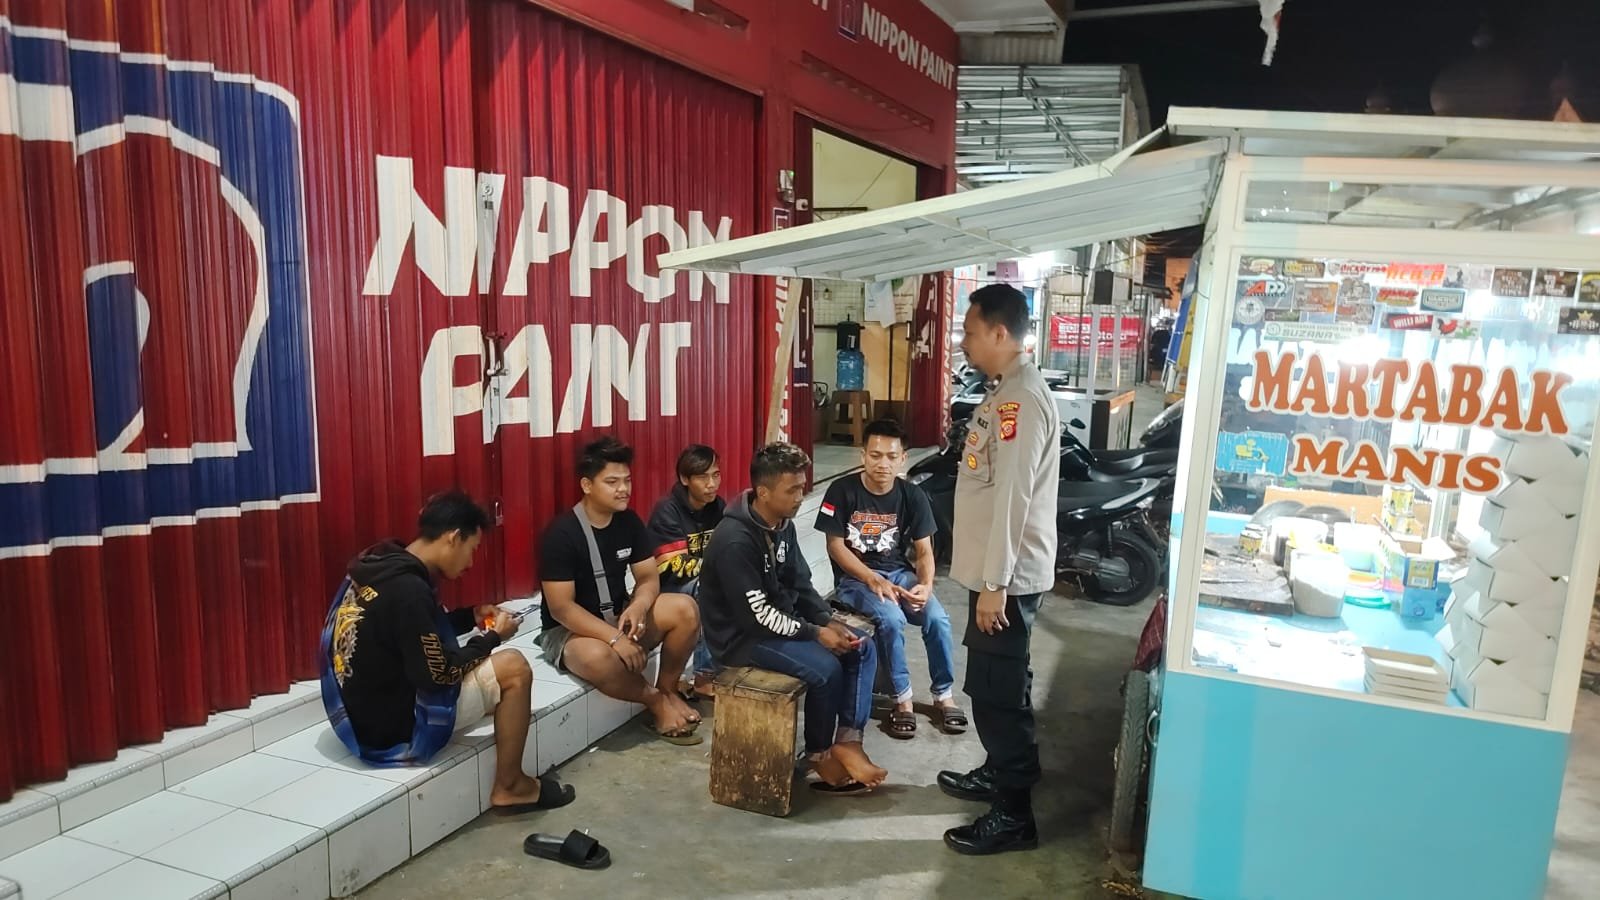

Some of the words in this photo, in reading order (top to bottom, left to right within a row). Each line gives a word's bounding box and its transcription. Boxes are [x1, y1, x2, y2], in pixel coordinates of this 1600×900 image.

[861, 2, 919, 69] NIPPON
[920, 45, 955, 90] PAINT
[362, 154, 732, 303] NIPPON
[944, 277, 952, 368] NIPPON
[421, 321, 691, 457] PAINT
[1249, 350, 1573, 435] MARTABAK
[1293, 438, 1502, 493] MANIS
